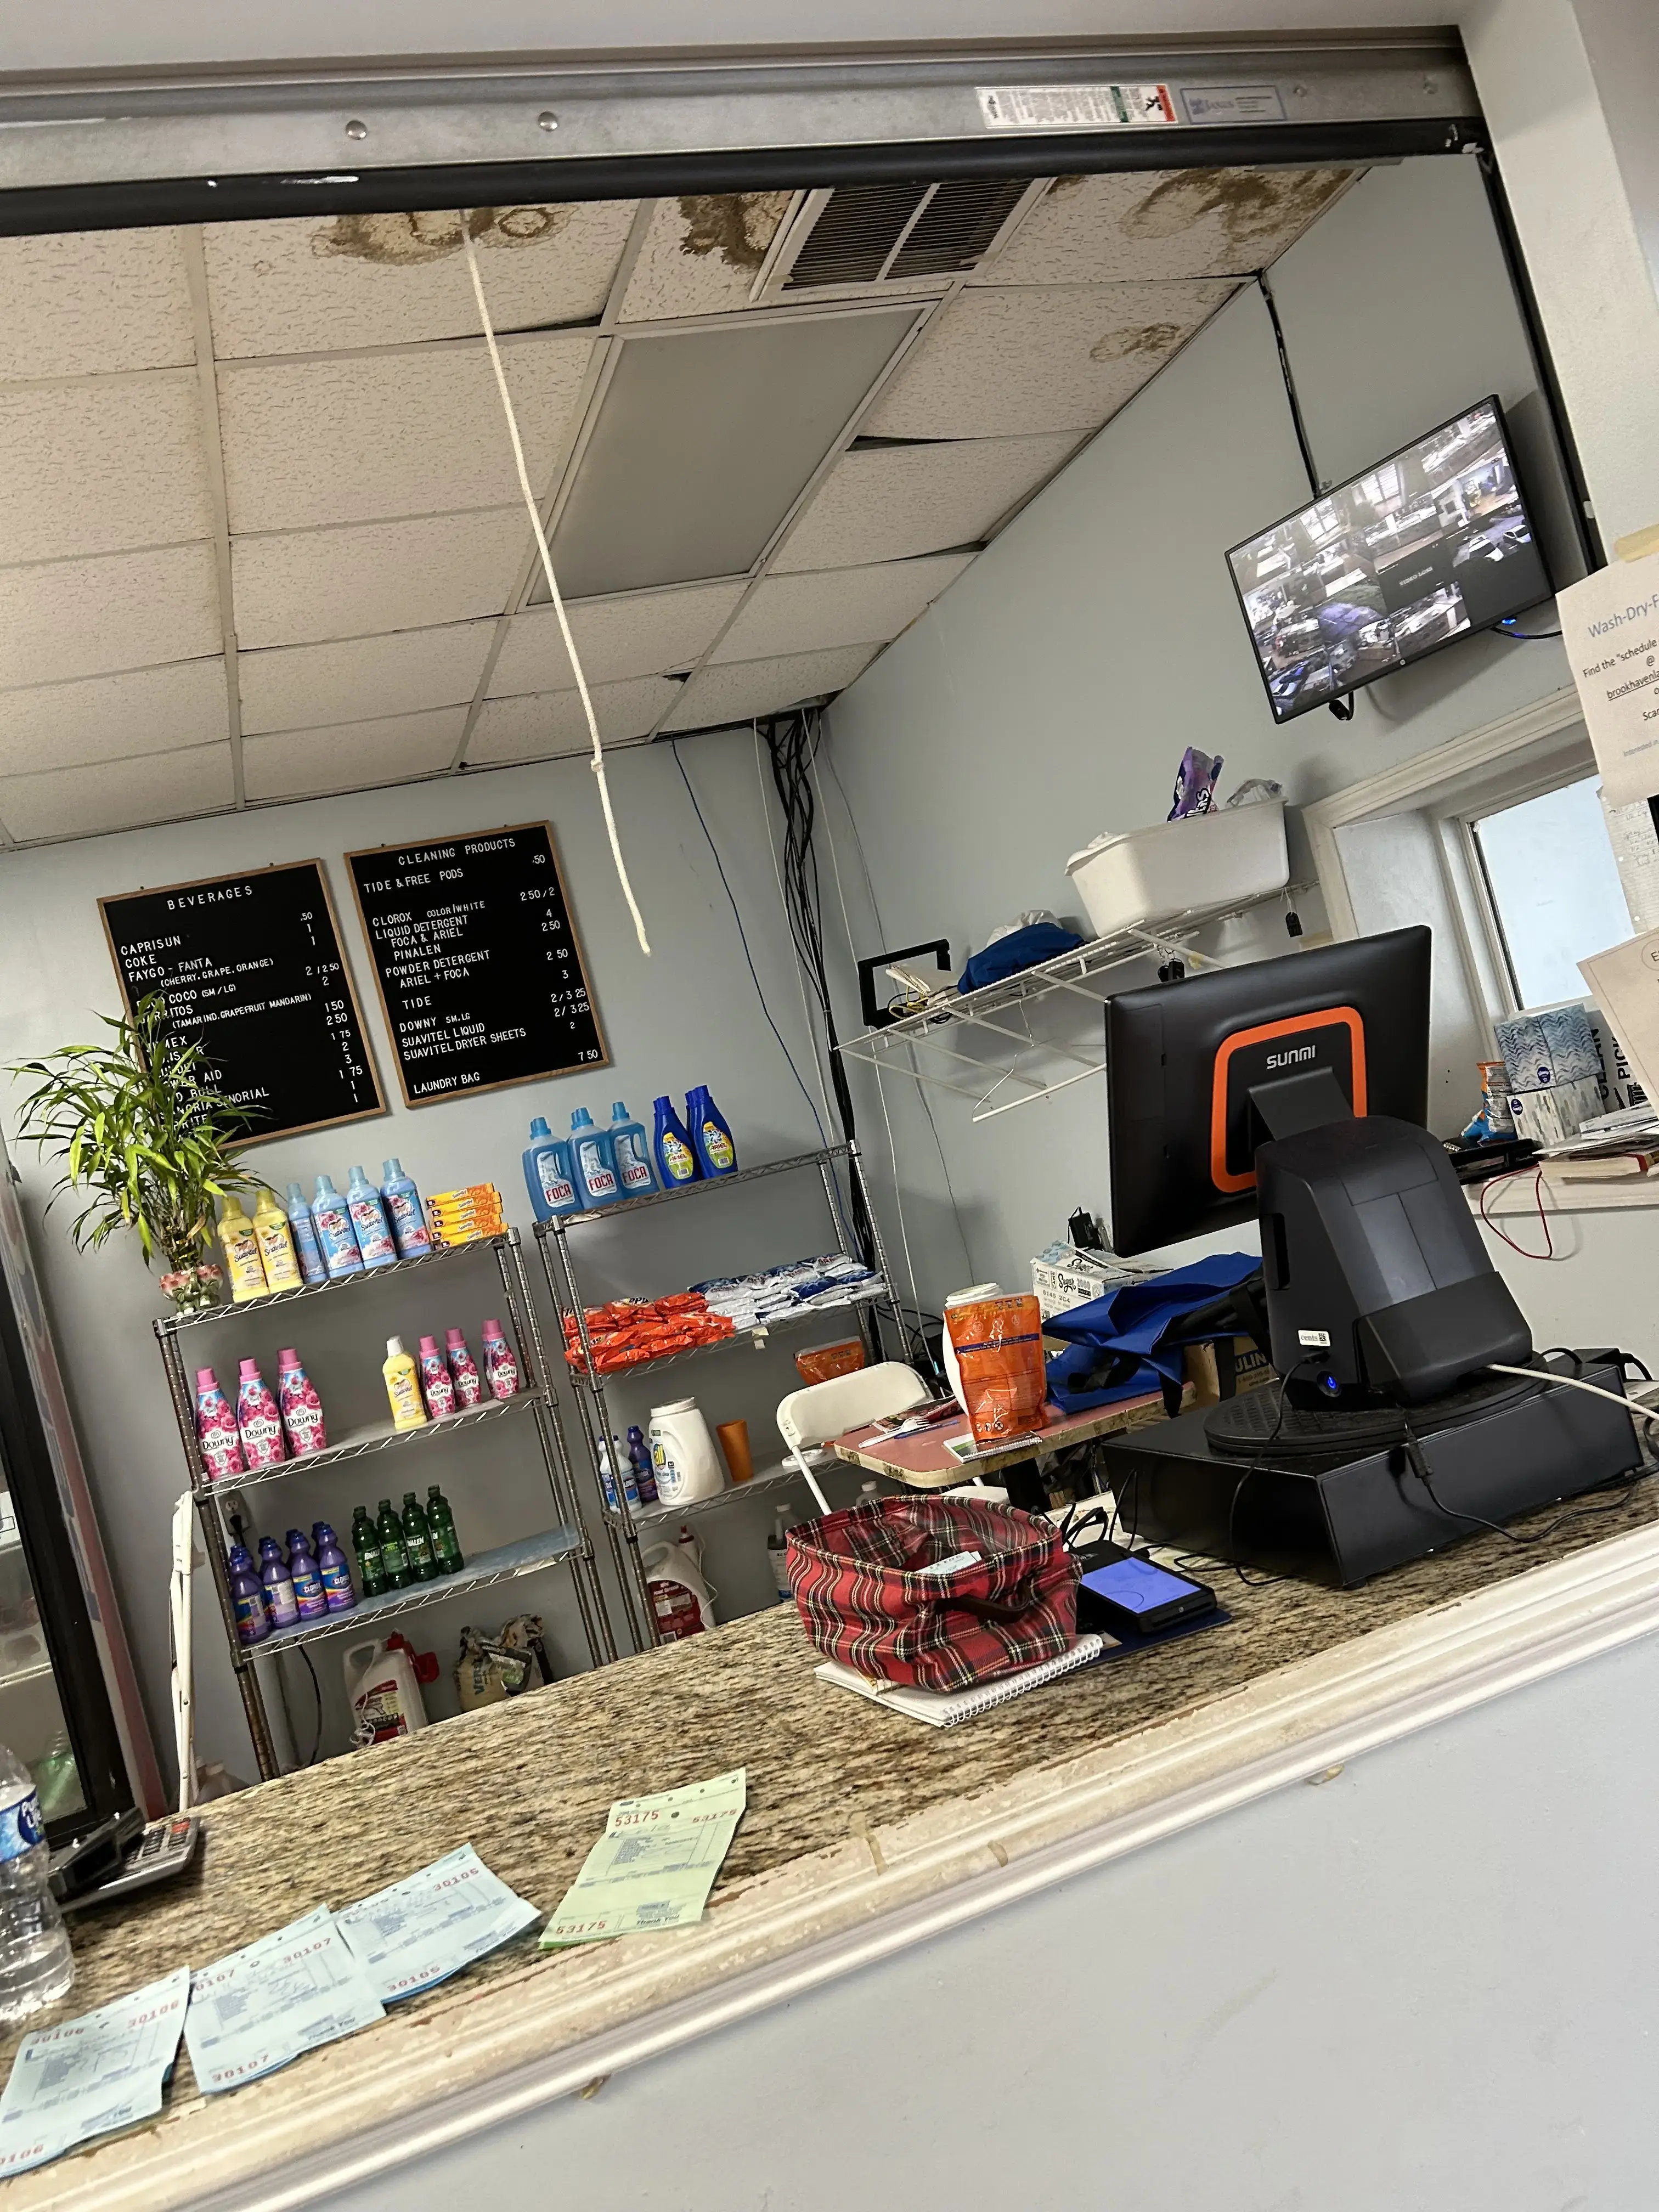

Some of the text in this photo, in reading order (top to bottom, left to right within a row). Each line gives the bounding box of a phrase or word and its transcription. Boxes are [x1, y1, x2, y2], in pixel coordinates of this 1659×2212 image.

[1583, 663, 1600, 678] Find
[1601, 658, 1616, 670] the
[1646, 655, 1655, 667] @
[398, 838, 516, 866] CLEANING PRODUCTS
[363, 880, 392, 893] TIDE
[439, 868, 464, 881] PODS
[532, 855, 545, 864] .50
[167, 885, 252, 910] BEVERAGES
[373, 912, 413, 927] CLOROX
[375, 915, 468, 940] LIQUID DETERGENT
[391, 909, 552, 948] FOCA & ARIEL 4
[121, 912, 313, 956] CAPRISUN .50
[125, 923, 311, 969] COKE 1
[394, 944, 441, 961] PINALEN
[128, 966, 165, 982] FAYGO
[178, 957, 212, 973] FANTA
[311, 936, 315, 945] 1
[385, 950, 489, 978] POWDER DETERGENT
[1651, 951, 1659, 962] E
[323, 976, 329, 986] 2
[400, 974, 431, 988] ARIEL
[444, 967, 470, 980] FOCA
[169, 990, 196, 1004] COCO
[402, 970, 568, 1009] TIDE 3
[269, 993, 312, 1008] MANDARIN)
[399, 1017, 436, 1032] DOWNY
[402, 1030, 450, 1047] SUAVITEL
[453, 1023, 485, 1037] LIQUID
[404, 1043, 454, 1060] SUAVITEL
[455, 1036, 487, 1050] DRYER
[490, 1028, 526, 1043] SHEETS
[204, 1070, 222, 1082] AID
[342, 1042, 349, 1051] 2
[345, 1054, 352, 1064] 3
[351, 1081, 355, 1090] 1
[414, 1076, 457, 1094] LAUNDRY
[461, 1072, 480, 1084] BAG
[353, 1093, 358, 1103] 1
[710, 1143, 727, 1151] ARIEL
[589, 1173, 613, 1191] FOCA
[622, 1166, 647, 1183] FOCA
[546, 1183, 571, 1202] FOCA
[361, 1216, 383, 1231] Suavitel
[393, 1209, 415, 1224] Suavitel
[329, 1225, 351, 1240] Suavitel
[1058, 1273, 1076, 1293] Sugar
[498, 1368, 515, 1378] Downy
[458, 1378, 477, 1387] Downy
[431, 1387, 449, 1397] Downy
[288, 1413, 318, 1426] Downy
[245, 1426, 276, 1438] Downy
[202, 1436, 234, 1450] Downy
[614, 1808, 737, 1826] 53175 53175
[433, 1868, 479, 1891] 30105
[556, 1920, 607, 1934] 53175
[283, 1938, 331, 1963] 30107
[387, 1966, 440, 1991] 30105
[128, 2000, 179, 2029] 30106
[212, 2054, 268, 2082] 30107
